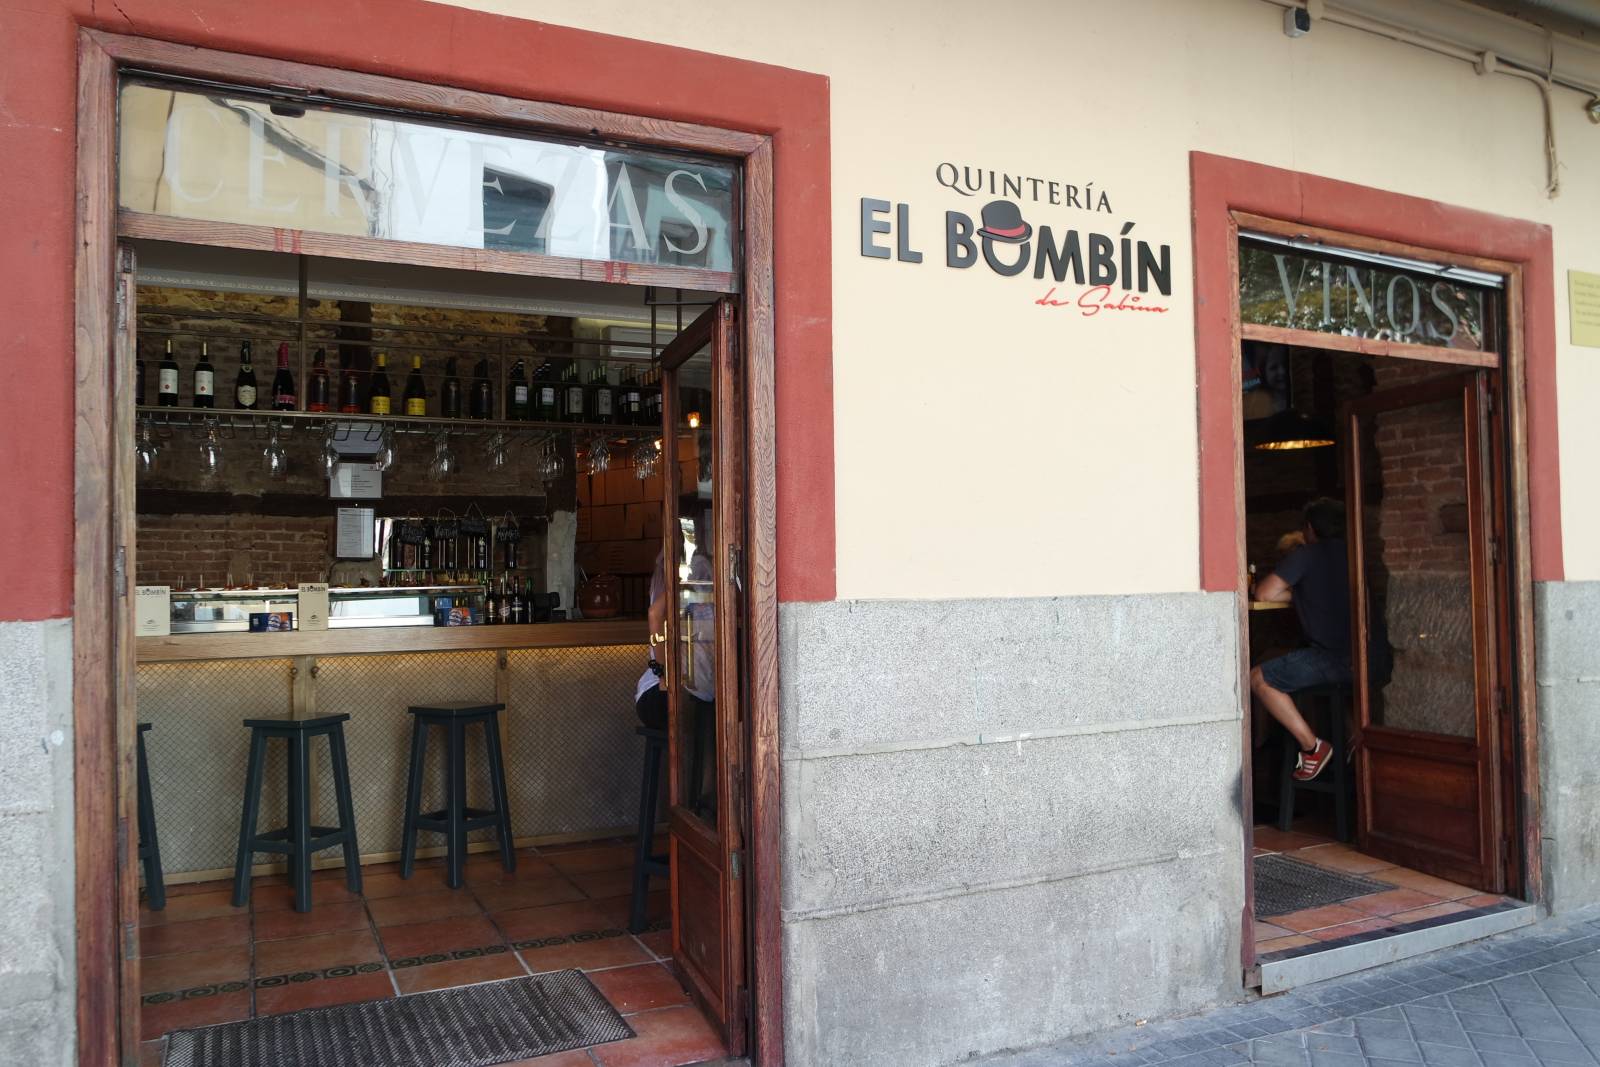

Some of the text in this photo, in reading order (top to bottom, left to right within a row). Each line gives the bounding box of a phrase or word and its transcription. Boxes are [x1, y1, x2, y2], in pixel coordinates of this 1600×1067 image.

[165, 107, 708, 255] CERVEZAS
[936, 162, 1112, 214] QUINTERÍA
[861, 197, 1172, 297] EL BOMBÍN
[1035, 285, 1169, 316] de Sabina
[1273, 254, 1458, 341] VINOS
